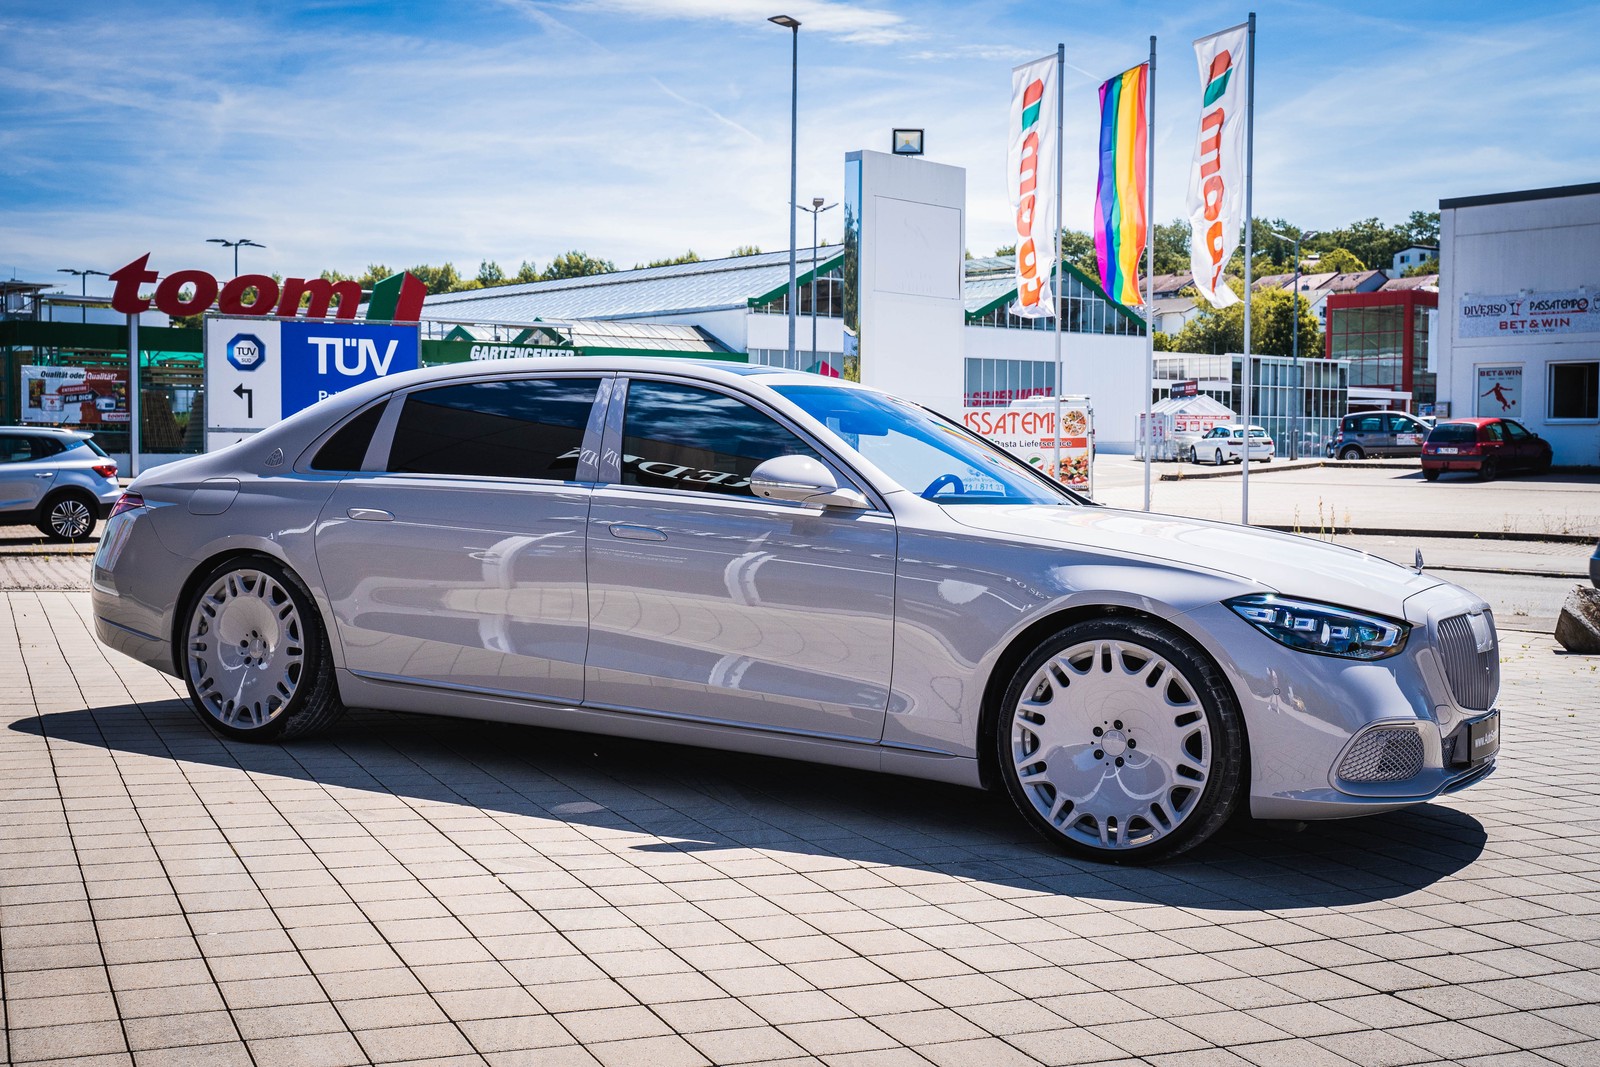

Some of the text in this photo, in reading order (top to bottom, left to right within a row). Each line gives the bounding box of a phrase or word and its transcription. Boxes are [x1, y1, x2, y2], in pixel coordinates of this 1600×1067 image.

[109, 252, 362, 319] toom
[236, 346, 257, 356] TÜV
[307, 336, 399, 376] TÜV
[40, 370, 68, 379] Qualität
[69, 371, 85, 379] oder
[1019, 440, 1072, 448] Lieferserice
